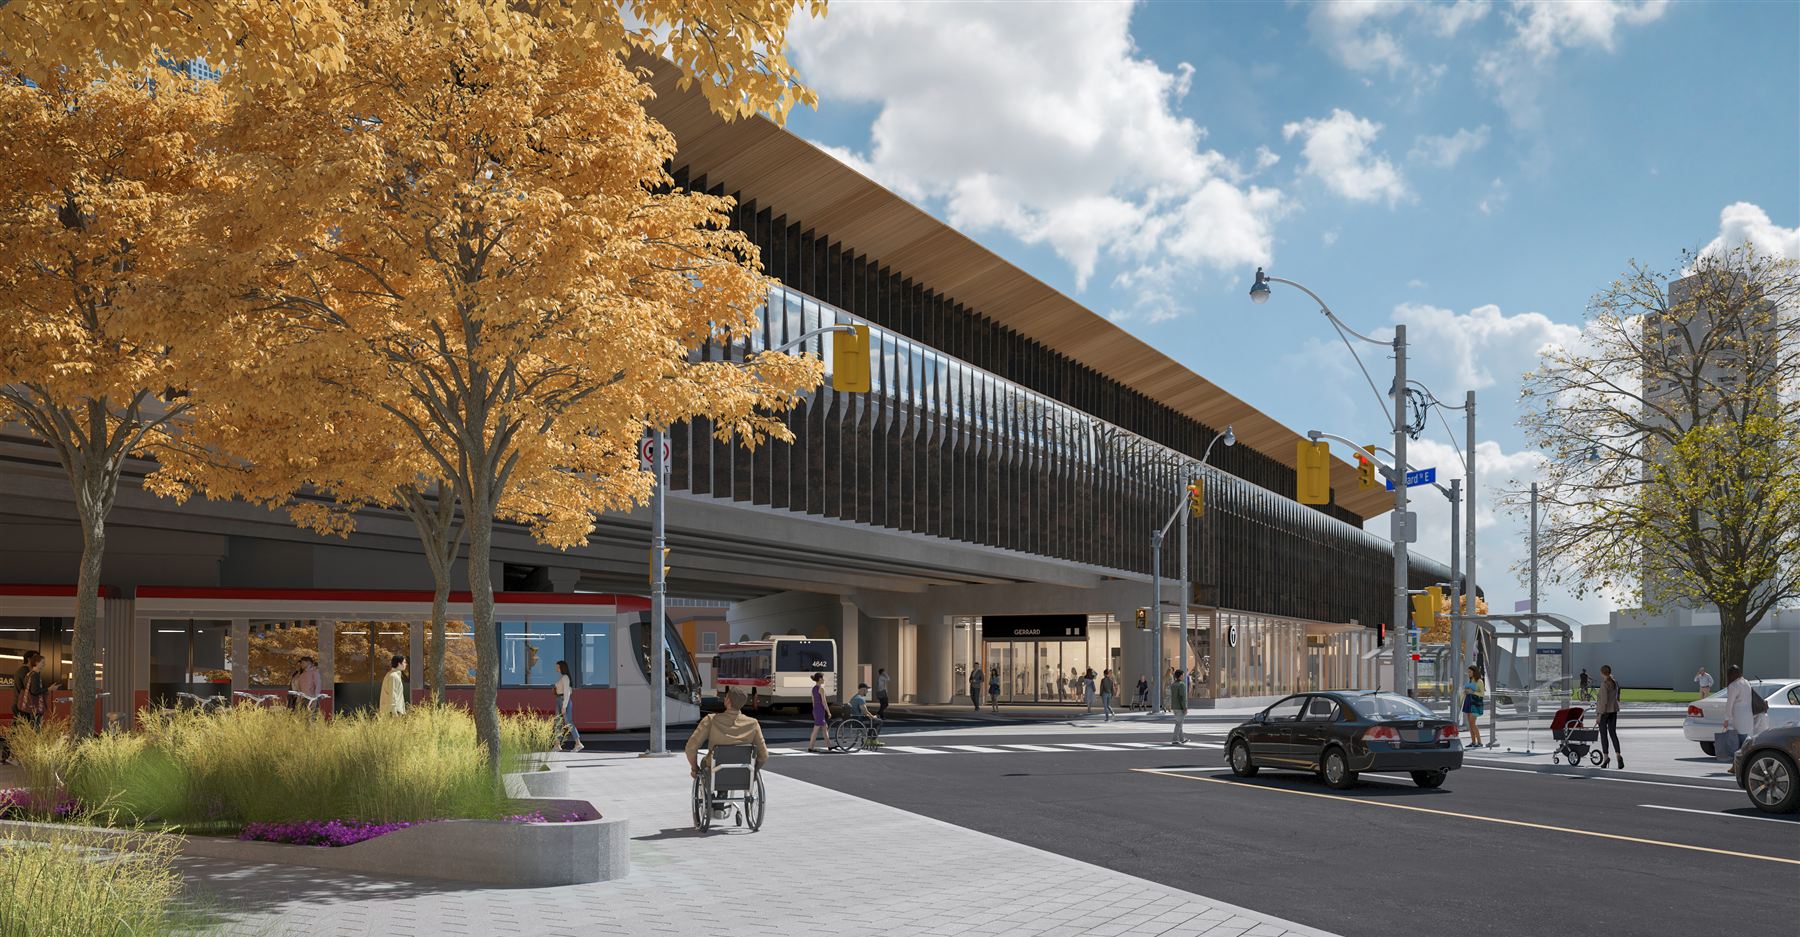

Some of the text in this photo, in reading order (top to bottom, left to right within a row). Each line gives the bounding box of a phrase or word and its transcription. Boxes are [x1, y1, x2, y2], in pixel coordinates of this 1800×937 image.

[1407, 473, 1419, 485] ard
[1424, 472, 1430, 482] E
[1013, 628, 1041, 636] GERRARD
